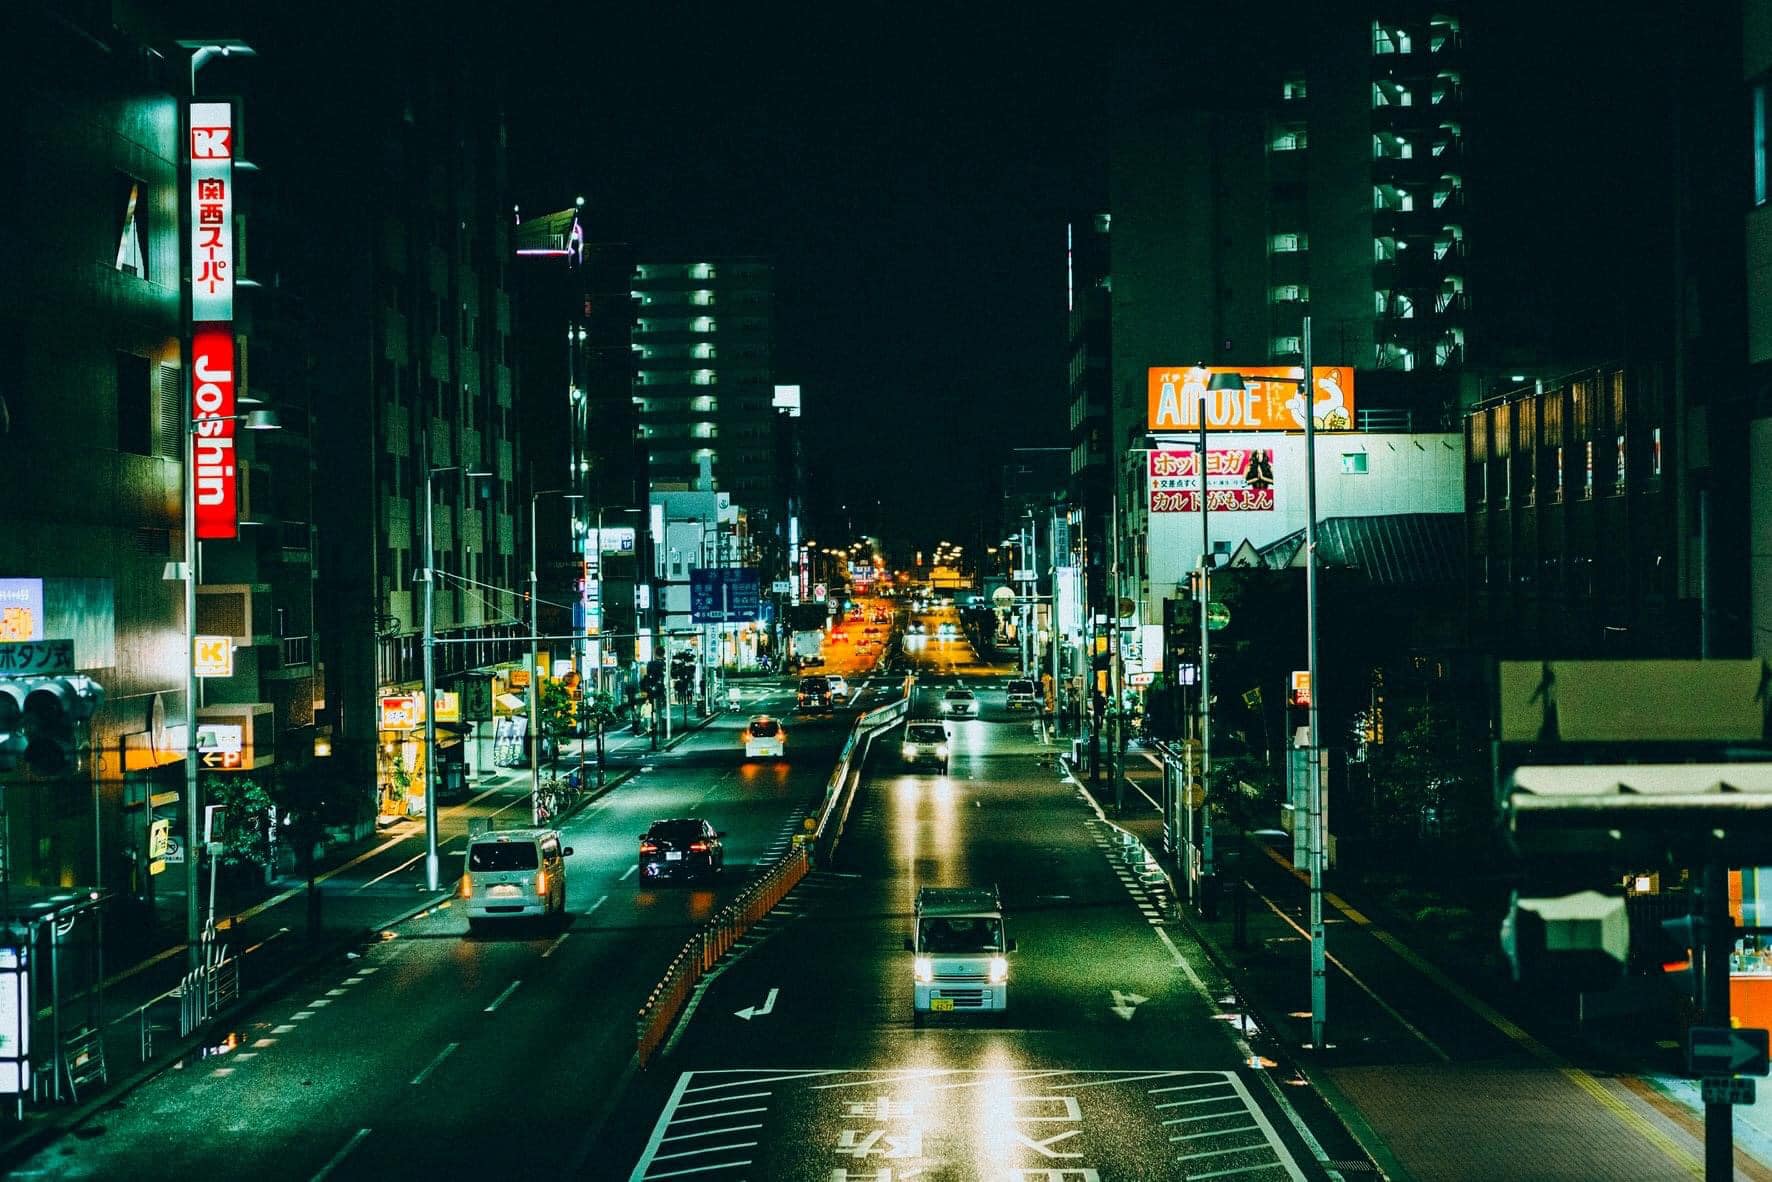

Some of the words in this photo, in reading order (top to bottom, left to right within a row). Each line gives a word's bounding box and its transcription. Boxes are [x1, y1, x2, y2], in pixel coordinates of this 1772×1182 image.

[193, 130, 231, 158] K
[197, 178, 227, 294] 関西スーパー
[1155, 382, 1261, 426] AMUSE
[193, 354, 234, 506] Joshin
[201, 642, 223, 662] K
[223, 753, 240, 767] P
